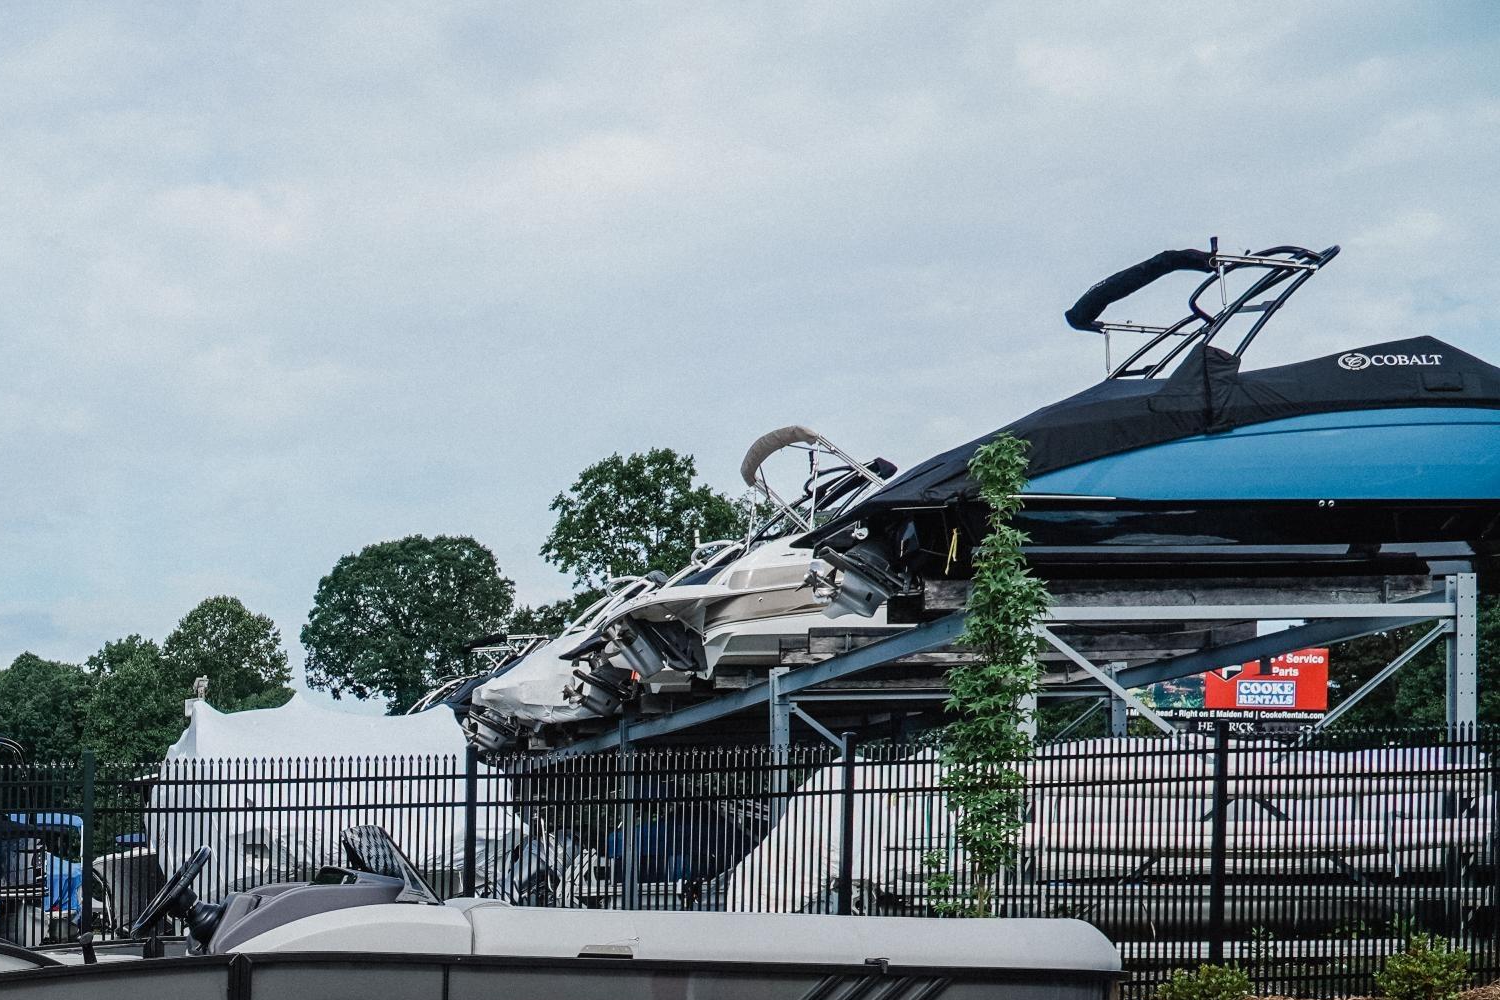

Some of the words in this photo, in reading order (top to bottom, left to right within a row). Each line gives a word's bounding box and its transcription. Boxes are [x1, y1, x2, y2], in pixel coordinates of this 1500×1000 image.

[1370, 354, 1443, 367] COBALT
[1285, 653, 1324, 664] Service
[1272, 666, 1299, 677] Parts
[1240, 682, 1294, 695] COOKE
[1238, 694, 1294, 705] RENTALS
[1178, 709, 1197, 719] Right
[1198, 710, 1209, 718] on
[1209, 710, 1215, 718] E
[1243, 710, 1254, 718] Rd
[1260, 710, 1325, 719] CookeRentals.com
